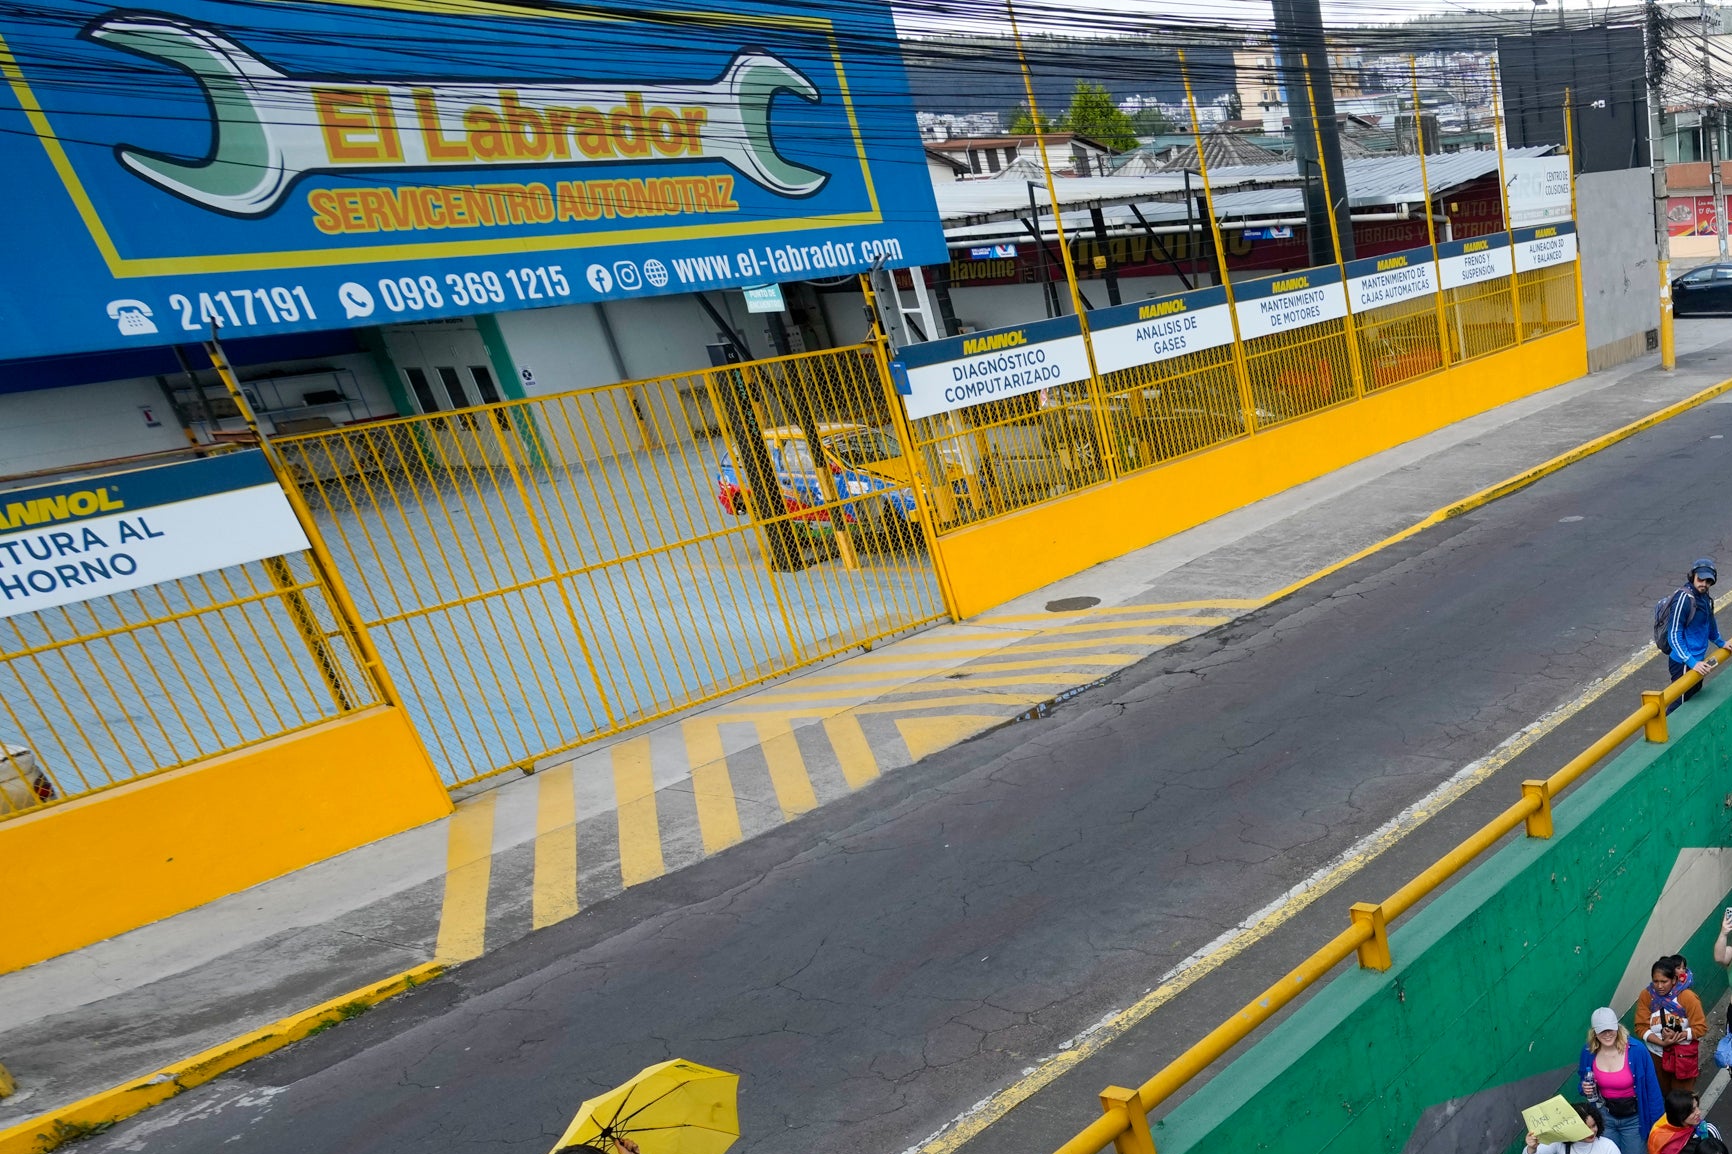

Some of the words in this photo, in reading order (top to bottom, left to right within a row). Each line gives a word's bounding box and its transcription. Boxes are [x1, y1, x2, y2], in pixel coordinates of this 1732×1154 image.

[310, 87, 404, 163] El
[411, 88, 707, 162] Labrador
[1547, 172, 1562, 181] CENTRO
[1545, 184, 1569, 196] COLISIONES
[308, 184, 556, 235] SERVICENTRO
[556, 175, 740, 222] AUTOMOTRIZ
[1463, 239, 1490, 253] MANNOL
[1538, 250, 1563, 263] BALANCEO
[671, 237, 905, 285] www.el-labrador.com
[950, 256, 1016, 284] Havoline
[1377, 255, 1408, 271] MANNOL
[1464, 256, 1486, 267] FRENOS
[379, 276, 445, 314] 098
[446, 270, 505, 308] 369
[506, 265, 572, 302] 1215
[1272, 275, 1310, 294] MANNOL
[1361, 271, 1415, 291] MANTENIMIENTO
[1415, 267, 1426, 278] DE
[169, 285, 318, 331] 2417191
[1139, 299, 1187, 320] MANNOL
[1261, 290, 1325, 314] MANTENIMIENTO
[1361, 292, 1383, 305] CAJAS
[1271, 315, 1282, 327] DE
[1283, 305, 1321, 325] MOTORES
[1136, 321, 1183, 342] ANALISIS
[1184, 315, 1198, 331] DE
[963, 331, 1027, 355] MANNOL
[1154, 339, 1187, 355] GASES
[952, 346, 1046, 382] DIAGNÓSTICO
[944, 364, 1061, 403] COMPUTARIZADO
[119, 517, 165, 544] AL
